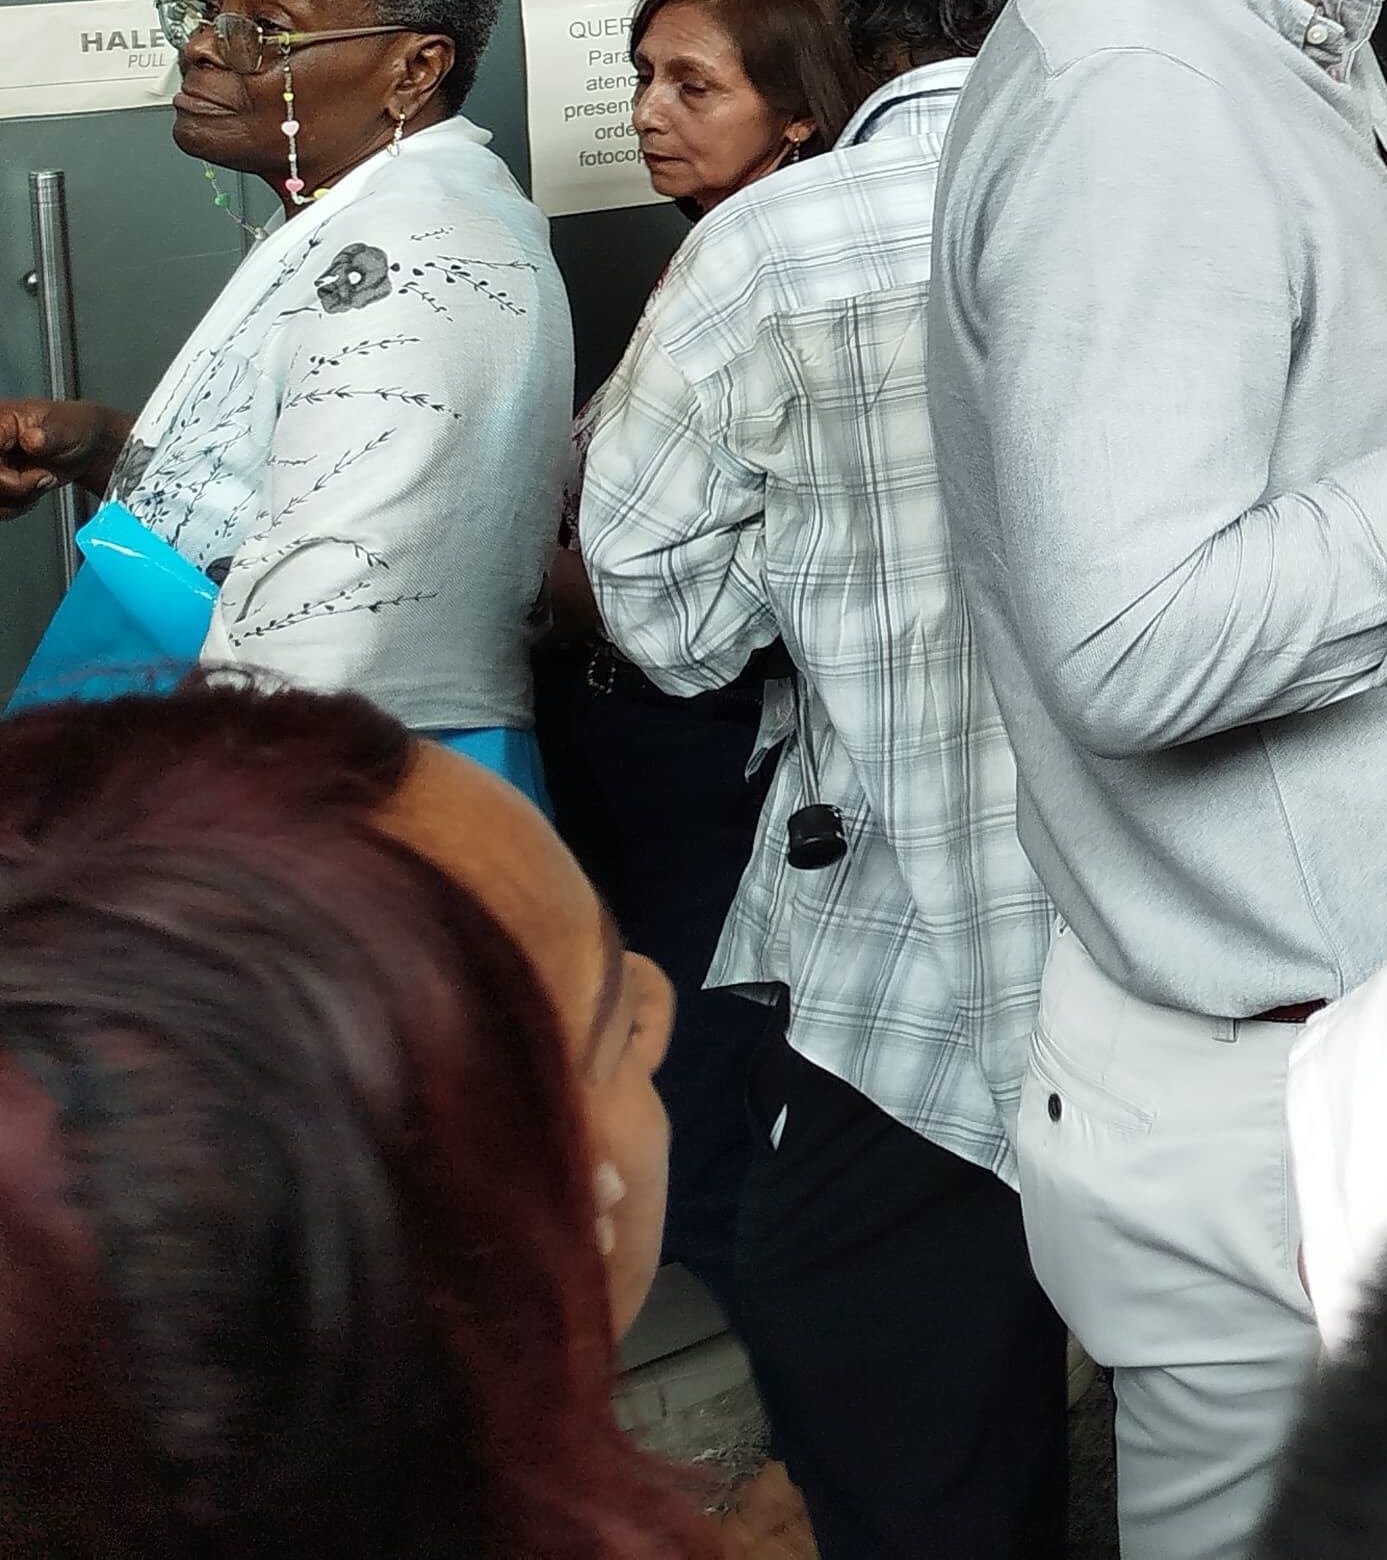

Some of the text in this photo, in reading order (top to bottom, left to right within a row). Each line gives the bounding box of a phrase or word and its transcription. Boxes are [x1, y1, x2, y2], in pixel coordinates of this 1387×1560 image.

[569, 16, 634, 39] QUER
[80, 28, 166, 53] HALE
[127, 54, 166, 68] PULL
[589, 49, 632, 66] Para
[586, 73, 640, 92] atenc
[564, 98, 637, 122] present
[594, 122, 641, 140] orde
[579, 147, 646, 167] fotocop
